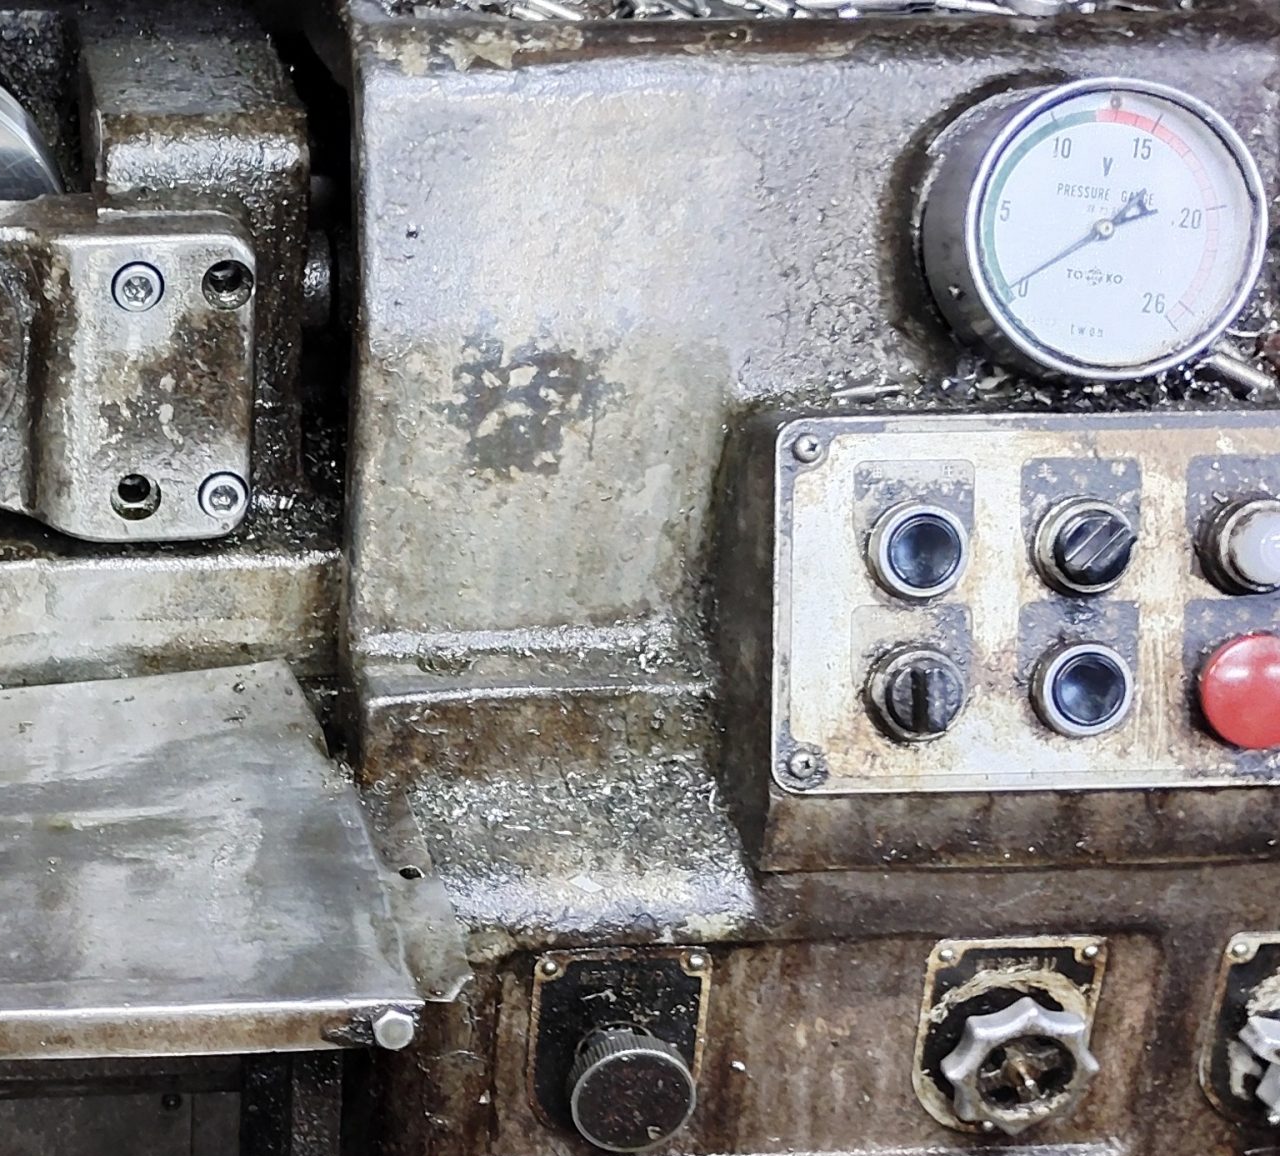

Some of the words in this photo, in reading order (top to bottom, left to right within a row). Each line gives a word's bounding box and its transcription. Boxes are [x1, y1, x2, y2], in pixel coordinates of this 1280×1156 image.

[1053, 137, 1071, 159] 10
[1132, 138, 1152, 160] 15
[1103, 157, 1113, 177] V
[1057, 182, 1110, 202] PRESSURE
[999, 200, 1011, 222] 5
[1179, 208, 1202, 230] 20
[1018, 279, 1029, 298] 0
[1142, 293, 1165, 315] 26
